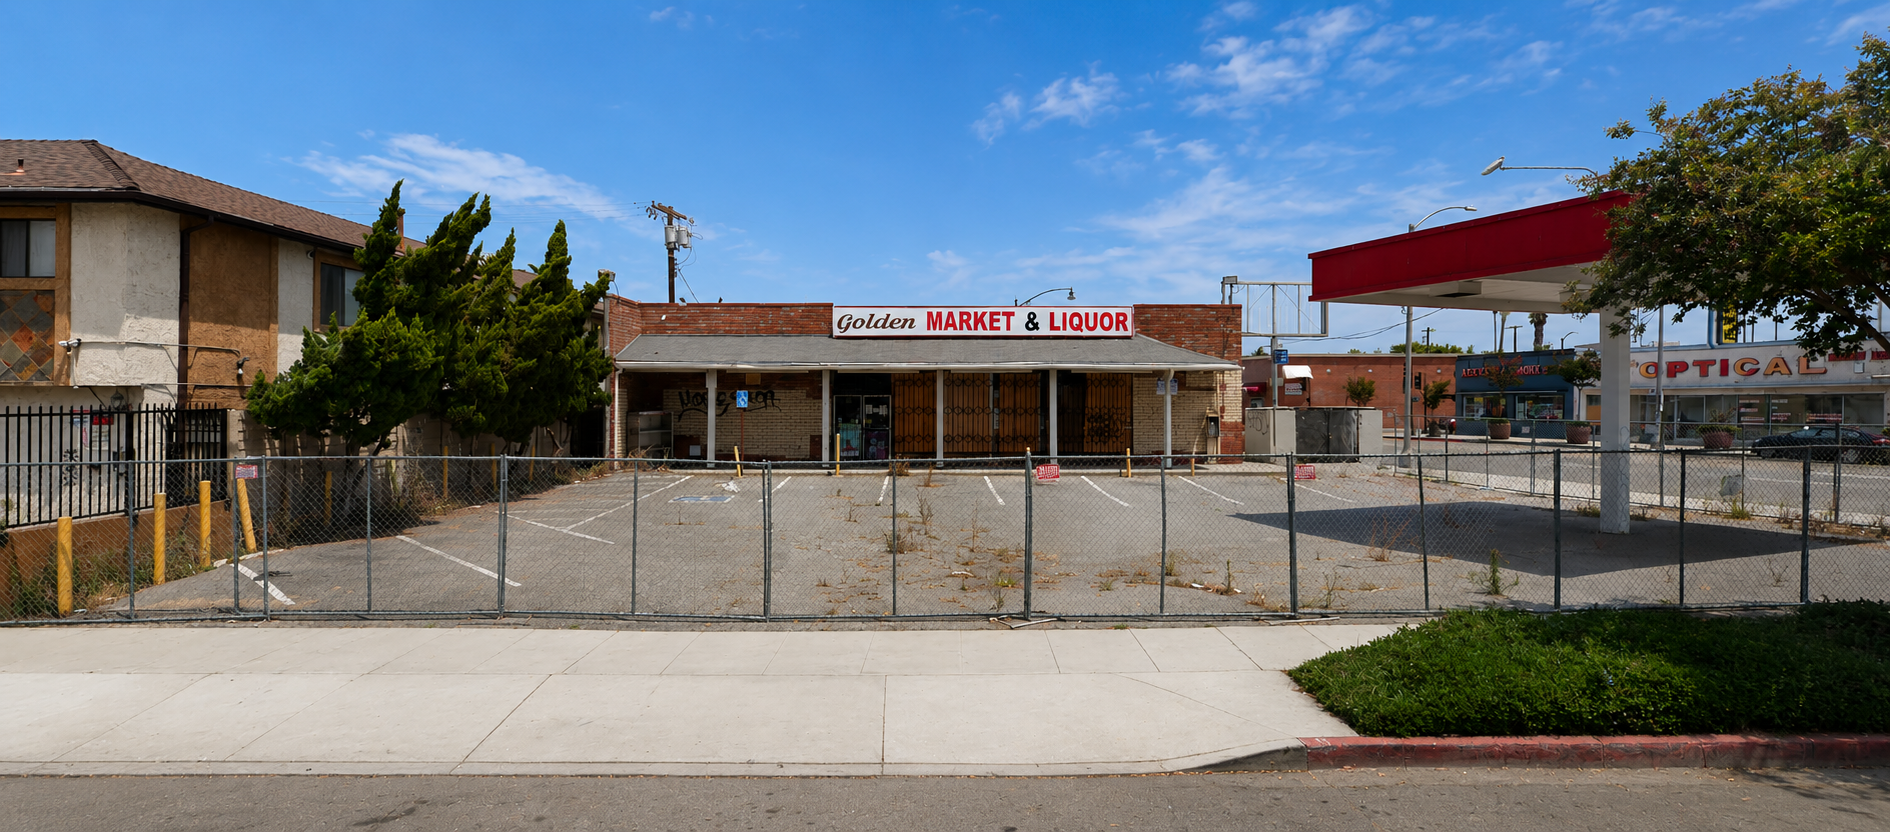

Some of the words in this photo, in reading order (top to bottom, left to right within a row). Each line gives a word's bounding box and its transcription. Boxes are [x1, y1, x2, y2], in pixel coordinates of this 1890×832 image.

[837, 313, 916, 333] Golden
[926, 311, 1015, 331] MARKET
[1024, 312, 1040, 331] &
[1049, 311, 1129, 332] LIQUOR
[1639, 357, 1828, 378] OPTICAL
